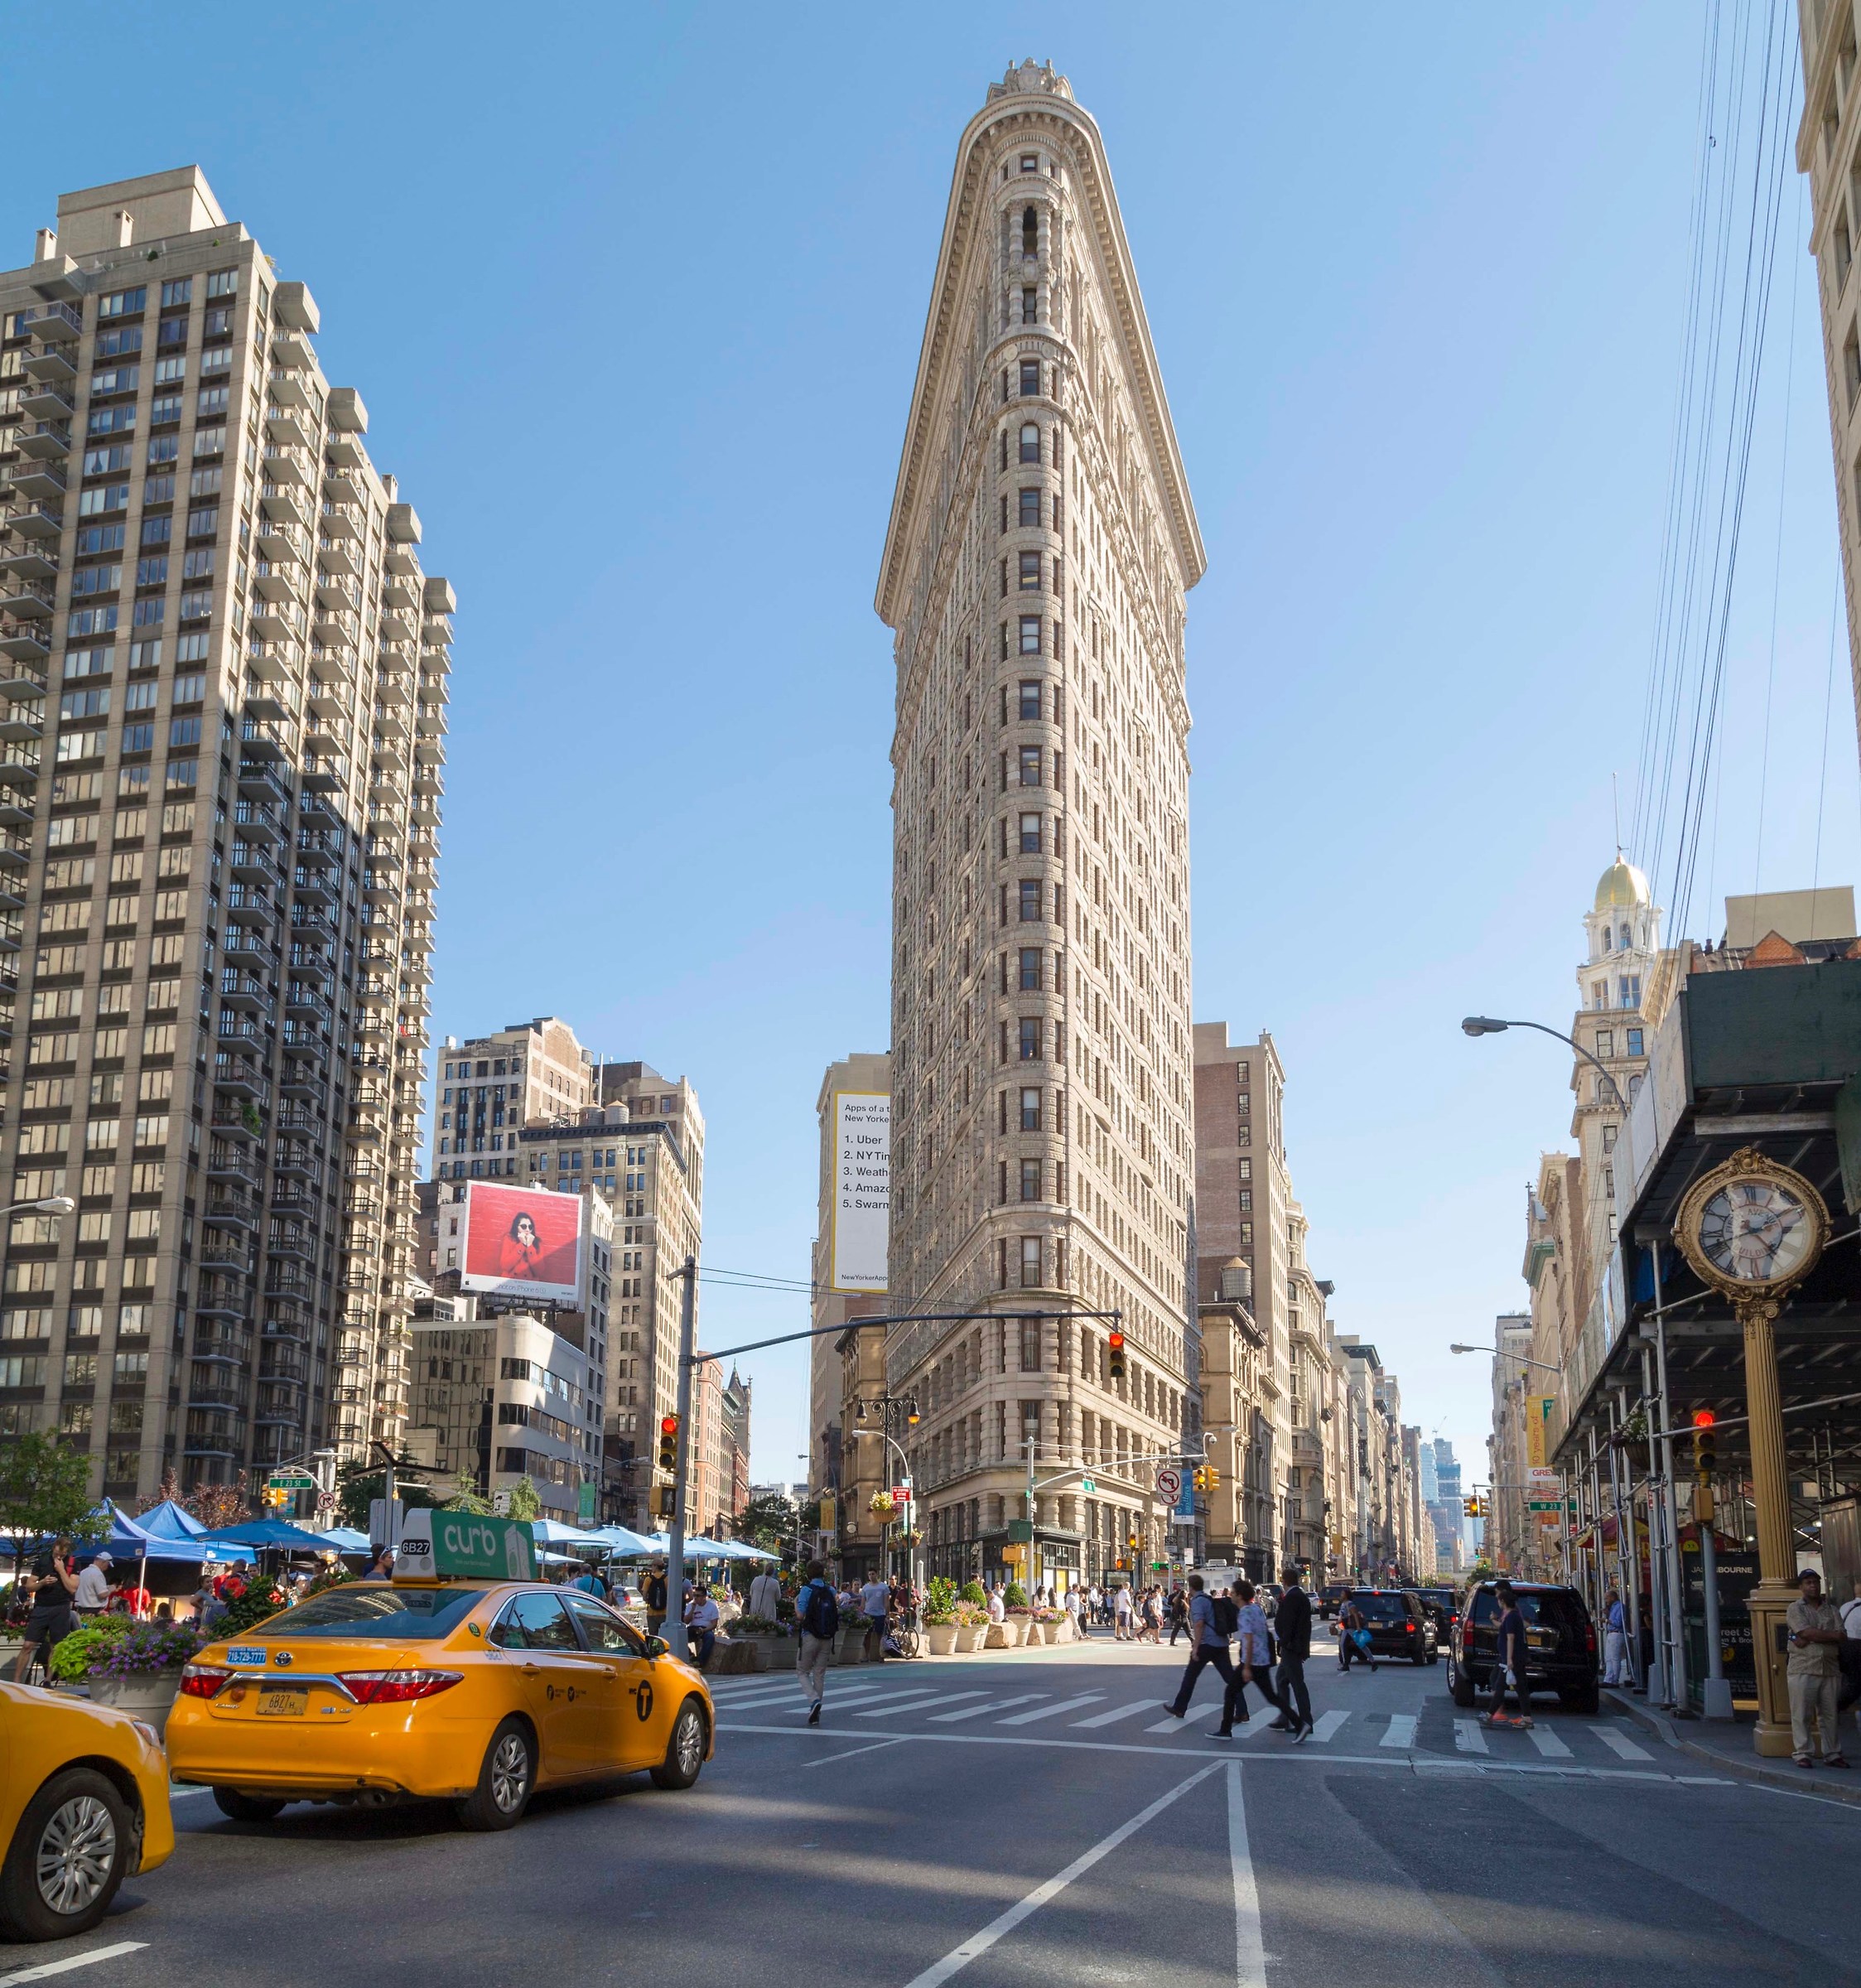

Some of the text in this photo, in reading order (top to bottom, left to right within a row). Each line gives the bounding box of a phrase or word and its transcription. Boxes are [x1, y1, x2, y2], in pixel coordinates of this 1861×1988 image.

[845, 1104, 866, 1112] Apps
[845, 1135, 883, 1144] 1. Uber
[844, 1151, 853, 1160] 2.
[843, 1166, 890, 1176] 3. Weath
[842, 1183, 852, 1192] 4.
[842, 1199, 852, 1208] 5.
[1533, 1428, 1542, 1454] years
[444, 1523, 496, 1556] curb
[402, 1542, 430, 1553] 6B27
[269, 1695, 291, 1709] 6B27
